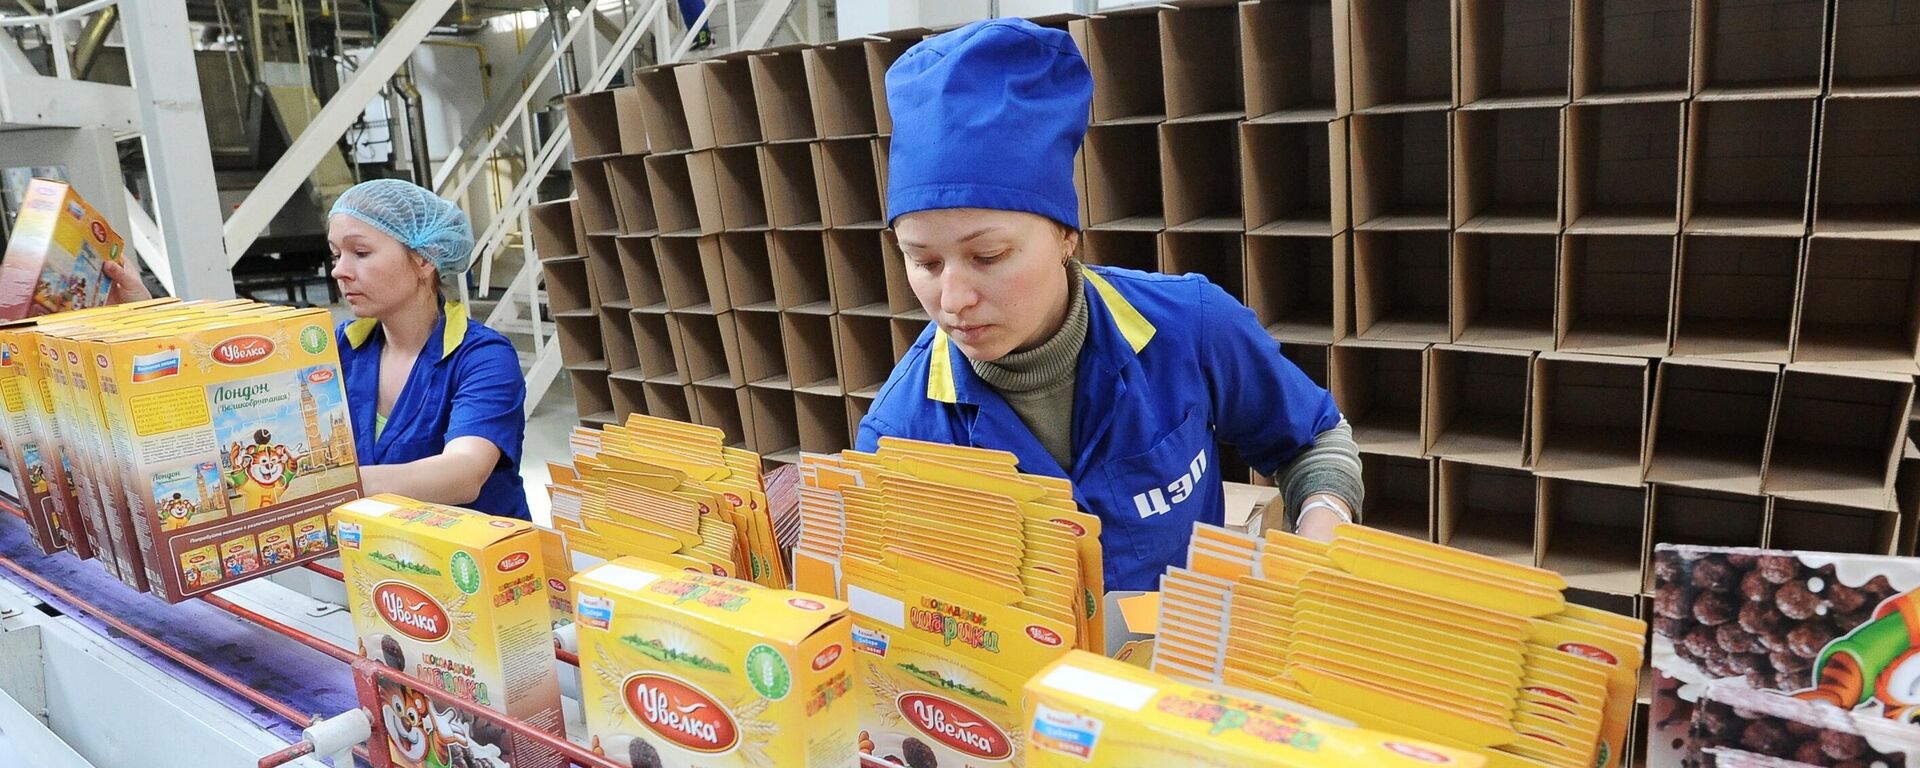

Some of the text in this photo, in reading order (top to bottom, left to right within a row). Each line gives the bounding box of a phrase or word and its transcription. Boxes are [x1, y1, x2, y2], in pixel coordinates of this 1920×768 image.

[221, 345, 265, 361] Увелка
[214, 382, 270, 404] Лондон
[382, 590, 437, 634] Увелка
[910, 607, 1000, 653] шарики
[637, 683, 718, 744] Увелка
[914, 699, 993, 753] Увелка
